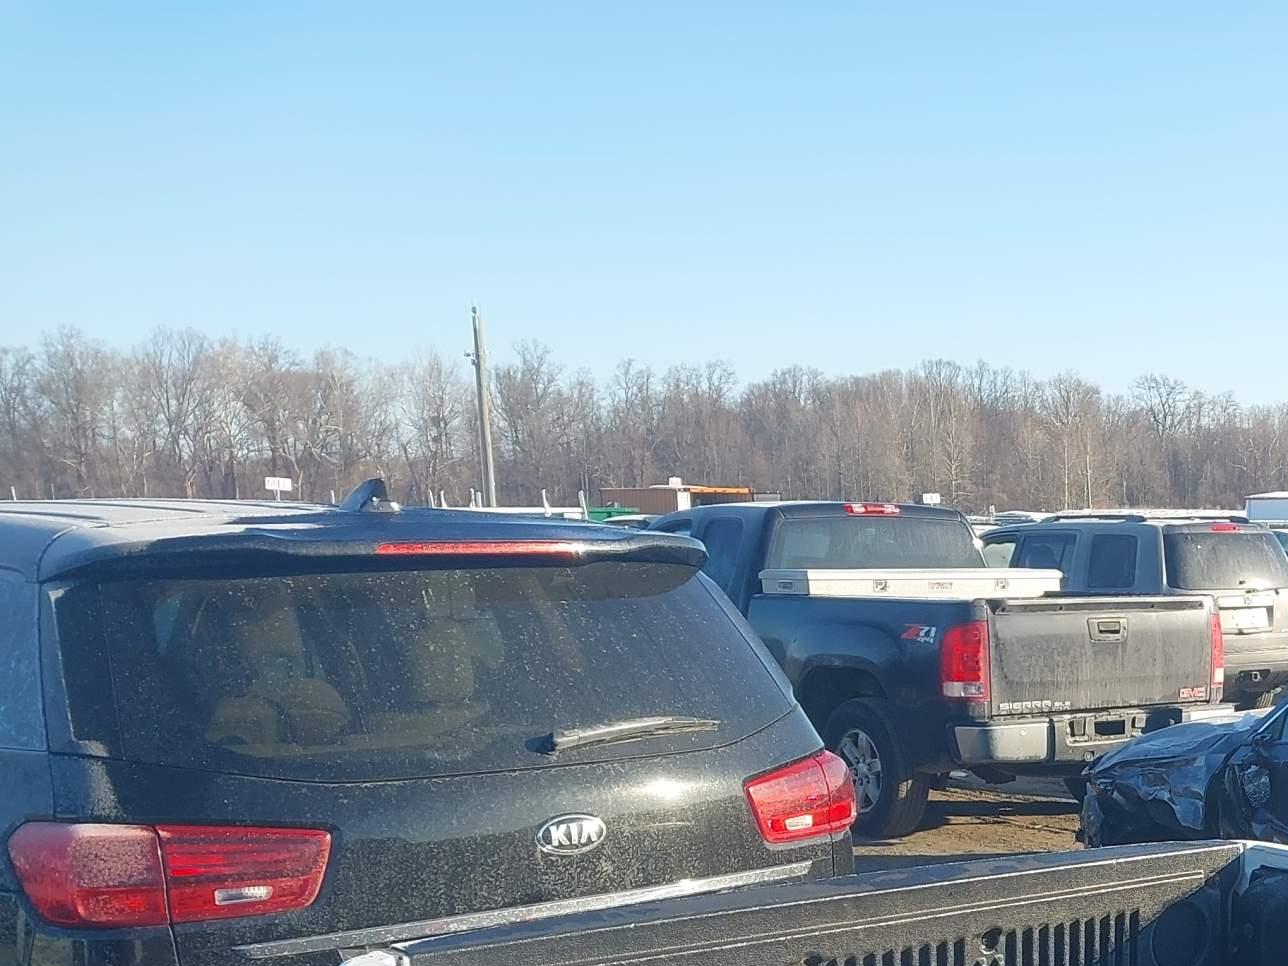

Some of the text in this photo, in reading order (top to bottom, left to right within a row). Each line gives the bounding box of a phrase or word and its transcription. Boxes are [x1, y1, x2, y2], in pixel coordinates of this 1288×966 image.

[1179, 687, 1206, 698] GMC
[999, 700, 1052, 710] SIERRA
[548, 820, 601, 846] KIA
